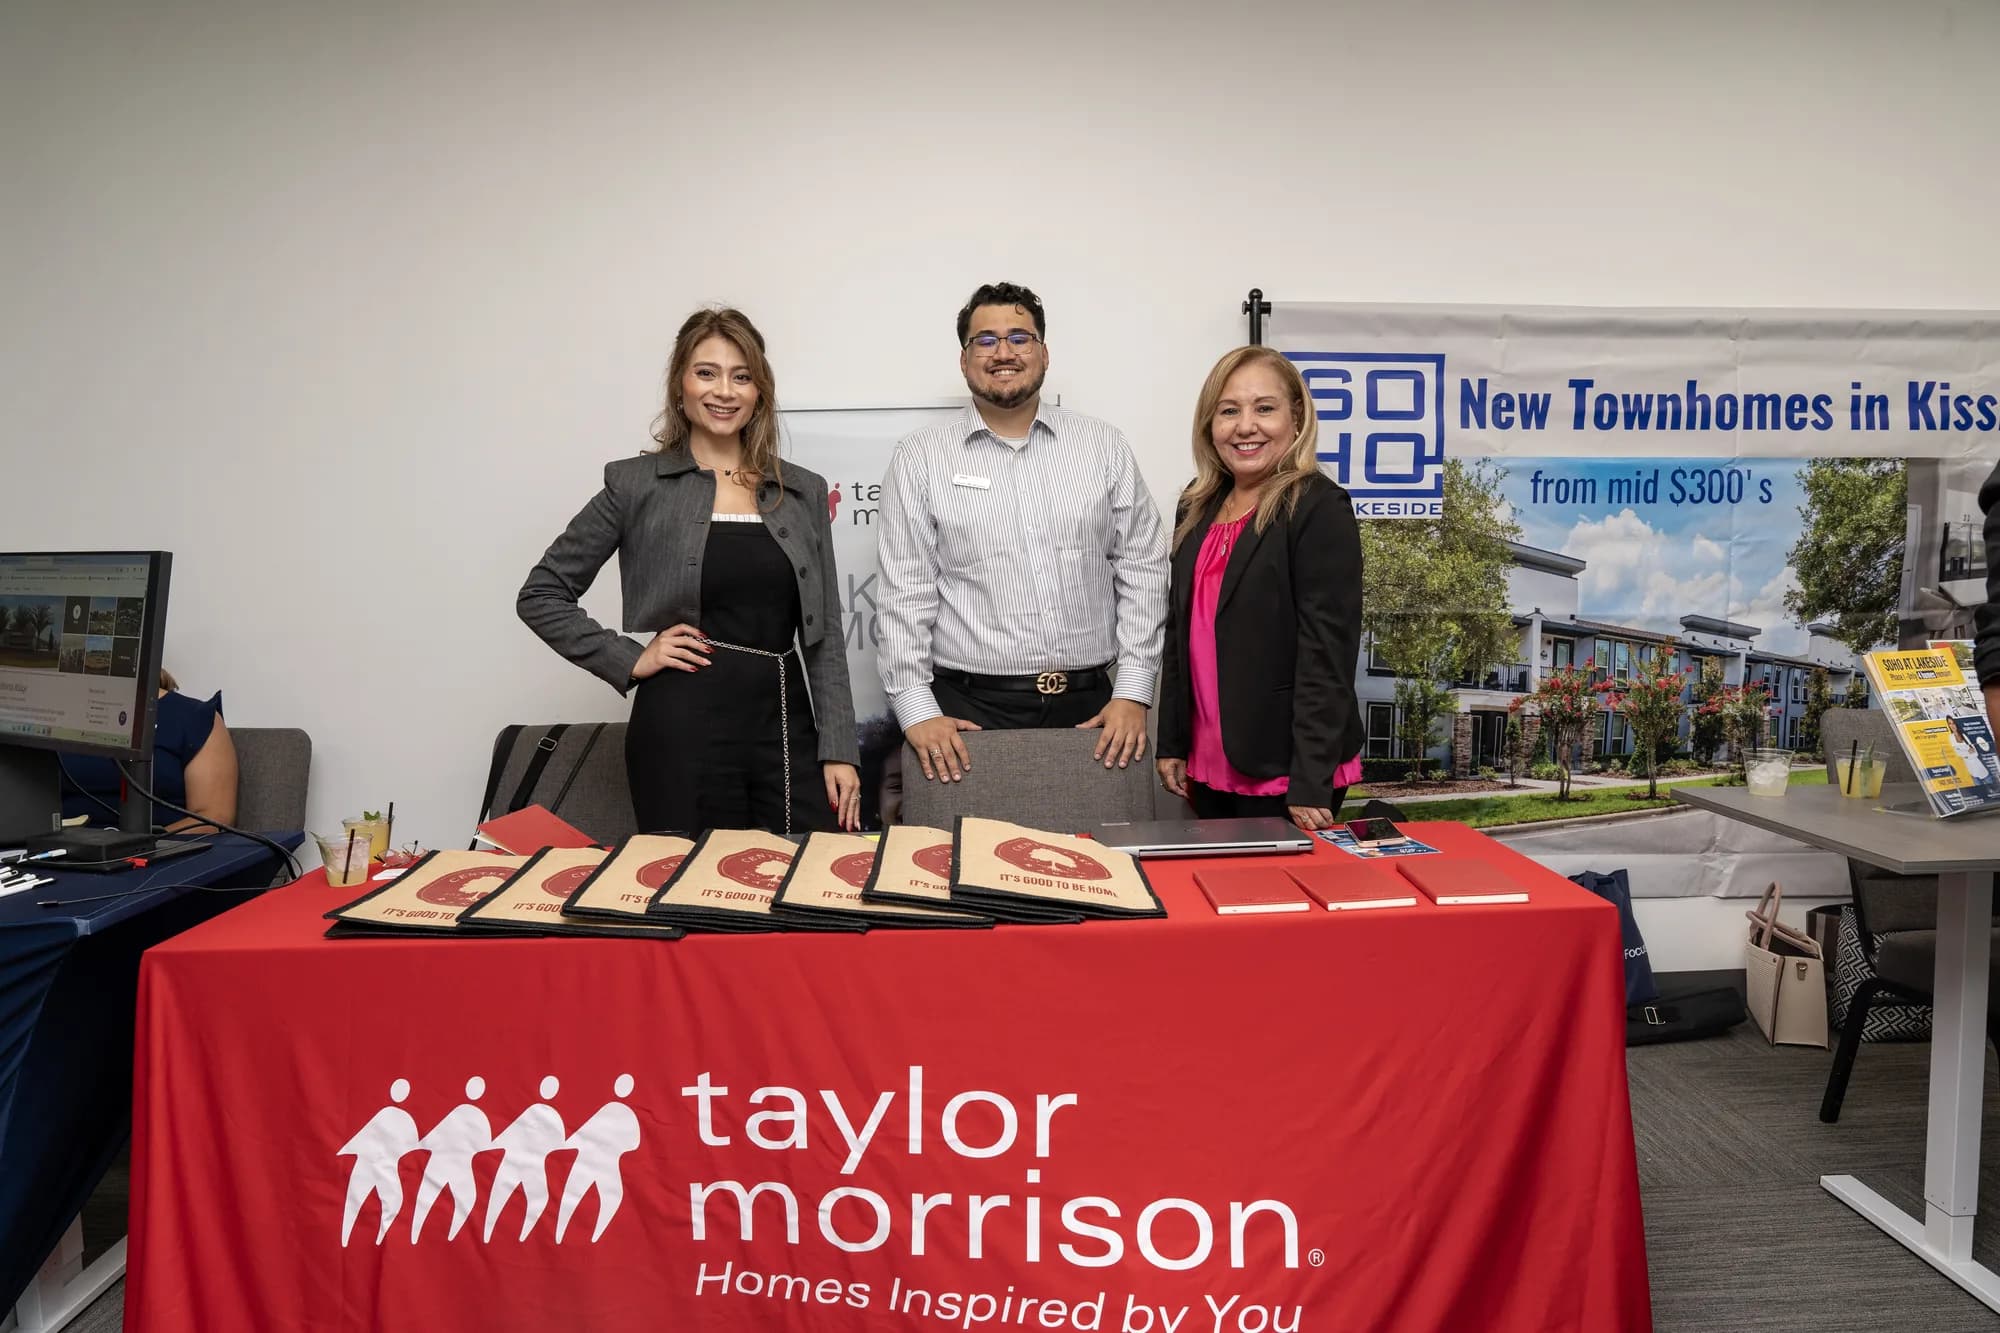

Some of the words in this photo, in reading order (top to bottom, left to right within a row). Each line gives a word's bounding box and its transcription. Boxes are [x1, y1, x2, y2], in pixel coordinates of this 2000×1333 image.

[1460, 378, 1551, 430] New
[1568, 379, 1834, 431] Townhomes
[1851, 381, 1889, 431] in
[1908, 381, 2000, 431] Kiss
[1530, 470, 1595, 504] from
[1607, 469, 1659, 504] mid
[1669, 466, 1773, 507] $300's
[1356, 502, 1443, 515] KESIDE
[1882, 658, 1905, 671] SOHO
[1903, 657, 1914, 670] AT
[1911, 656, 1949, 669] LAKESIDE
[909, 879, 930, 889] IT'S
[1000, 873, 1020, 883] IT'S
[1022, 876, 1053, 888] GOOD
[1056, 880, 1069, 890] TO
[1072, 883, 1086, 893] BE
[620, 893, 642, 904] IT'S
[701, 888, 723, 899] IT'S
[725, 889, 756, 901] GOOD
[822, 890, 843, 899] IT'S
[382, 907, 406, 919] IT'S
[406, 908, 436, 919] GOOD
[439, 911, 455, 920] TO
[512, 902, 535, 911] IT'S
[535, 903, 562, 913] GOO
[682, 1065, 1078, 1175] taylor
[696, 1261, 871, 1309] Homes
[889, 1278, 1106, 1331] Inspired
[1122, 1294, 1190, 1333] by
[1204, 1294, 1303, 1333] You
